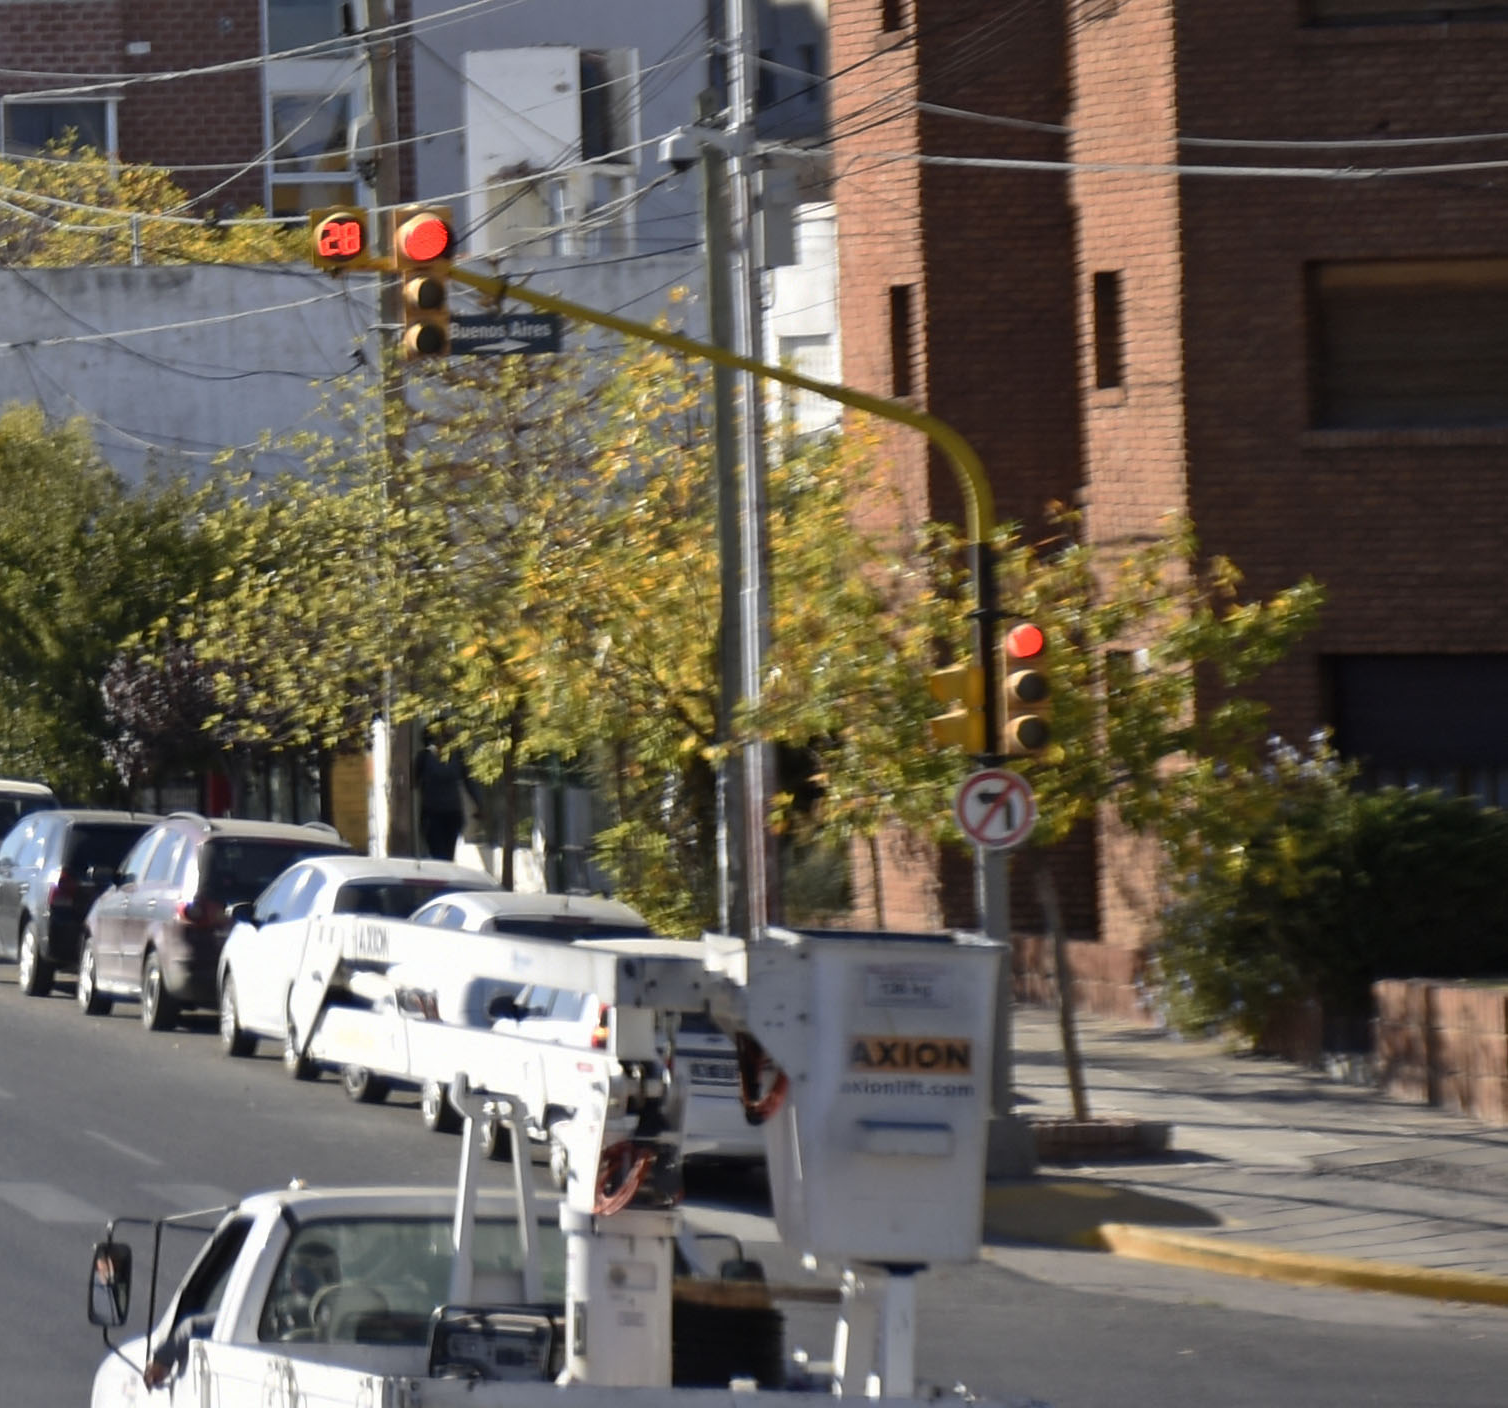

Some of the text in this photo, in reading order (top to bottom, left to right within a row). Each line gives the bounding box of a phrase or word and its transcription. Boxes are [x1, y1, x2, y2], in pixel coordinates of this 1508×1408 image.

[317, 221, 361, 256] 28
[449, 319, 552, 341] Buenos Aires
[851, 1041, 971, 1069] AXION
